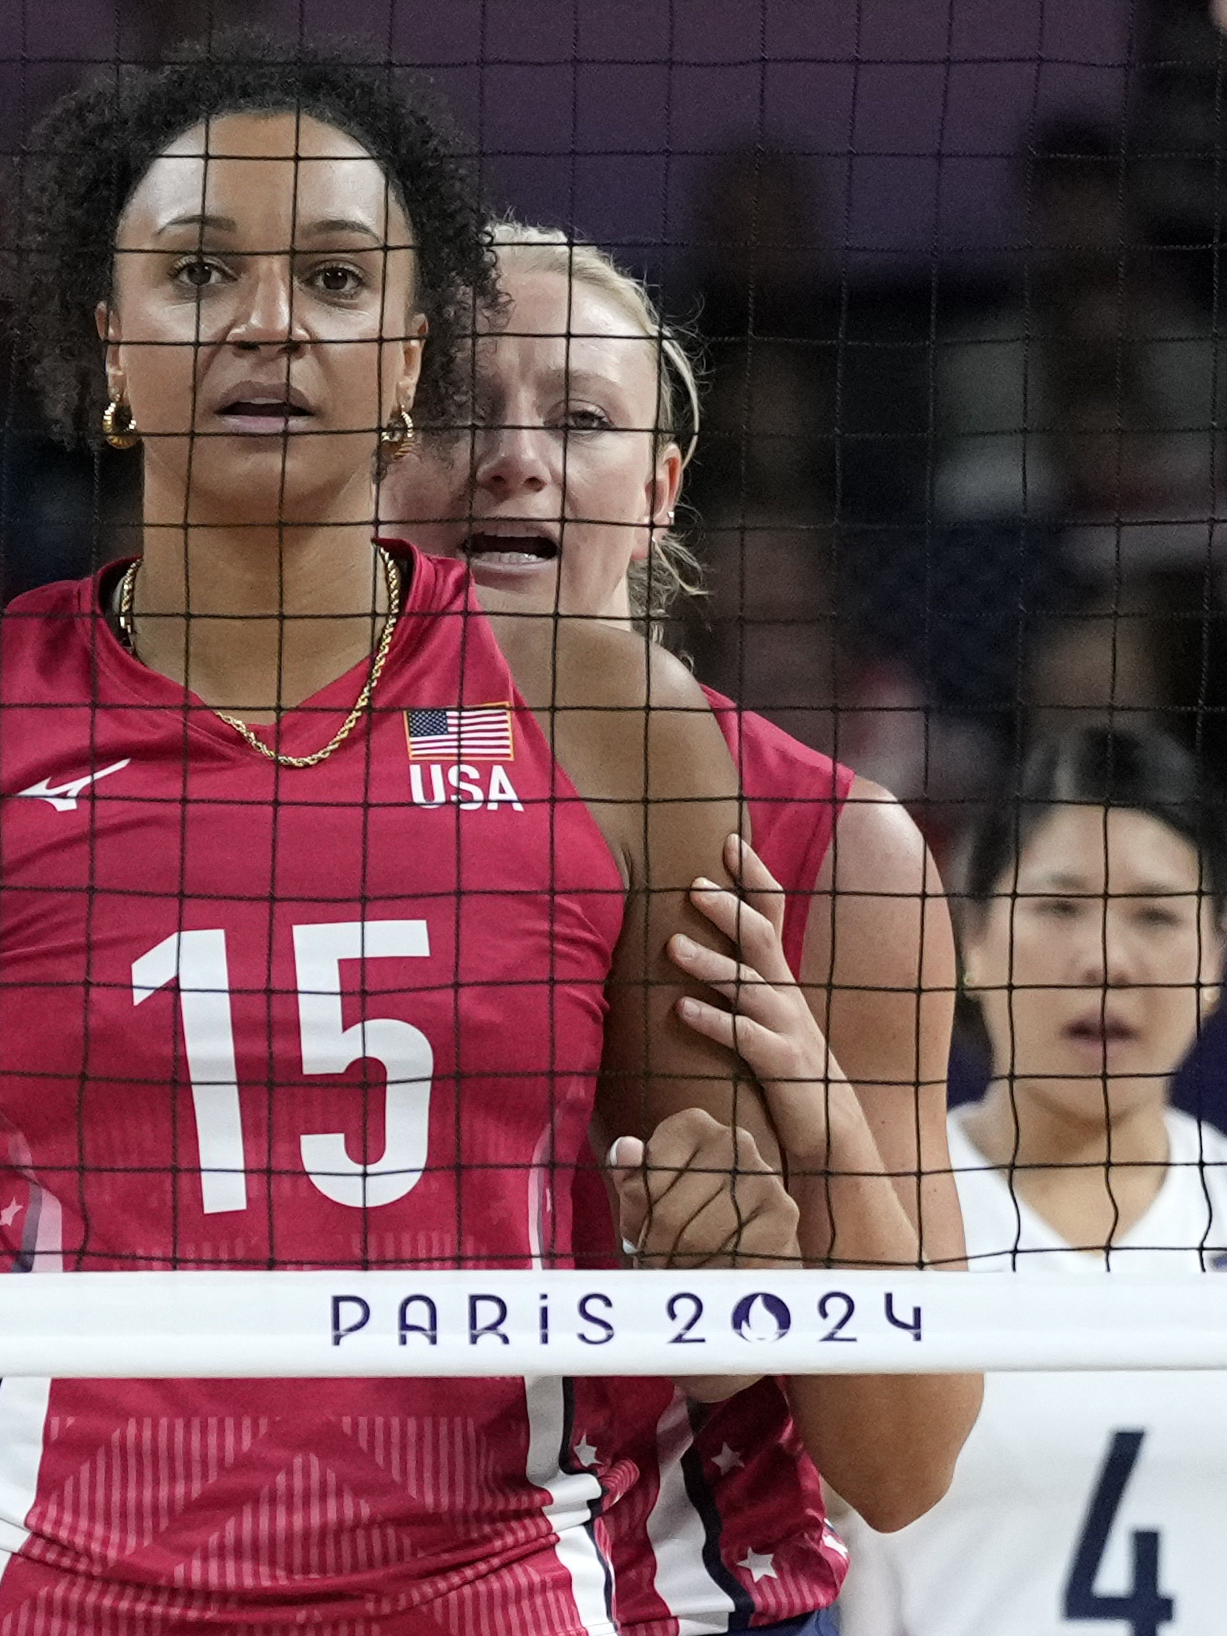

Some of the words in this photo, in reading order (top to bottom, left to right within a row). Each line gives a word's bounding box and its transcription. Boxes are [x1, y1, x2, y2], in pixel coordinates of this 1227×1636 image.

[409, 764, 524, 812] USA
[131, 919, 433, 1214] 15
[666, 1291, 922, 1343] 2024
[1063, 1430, 1176, 1636] 4
